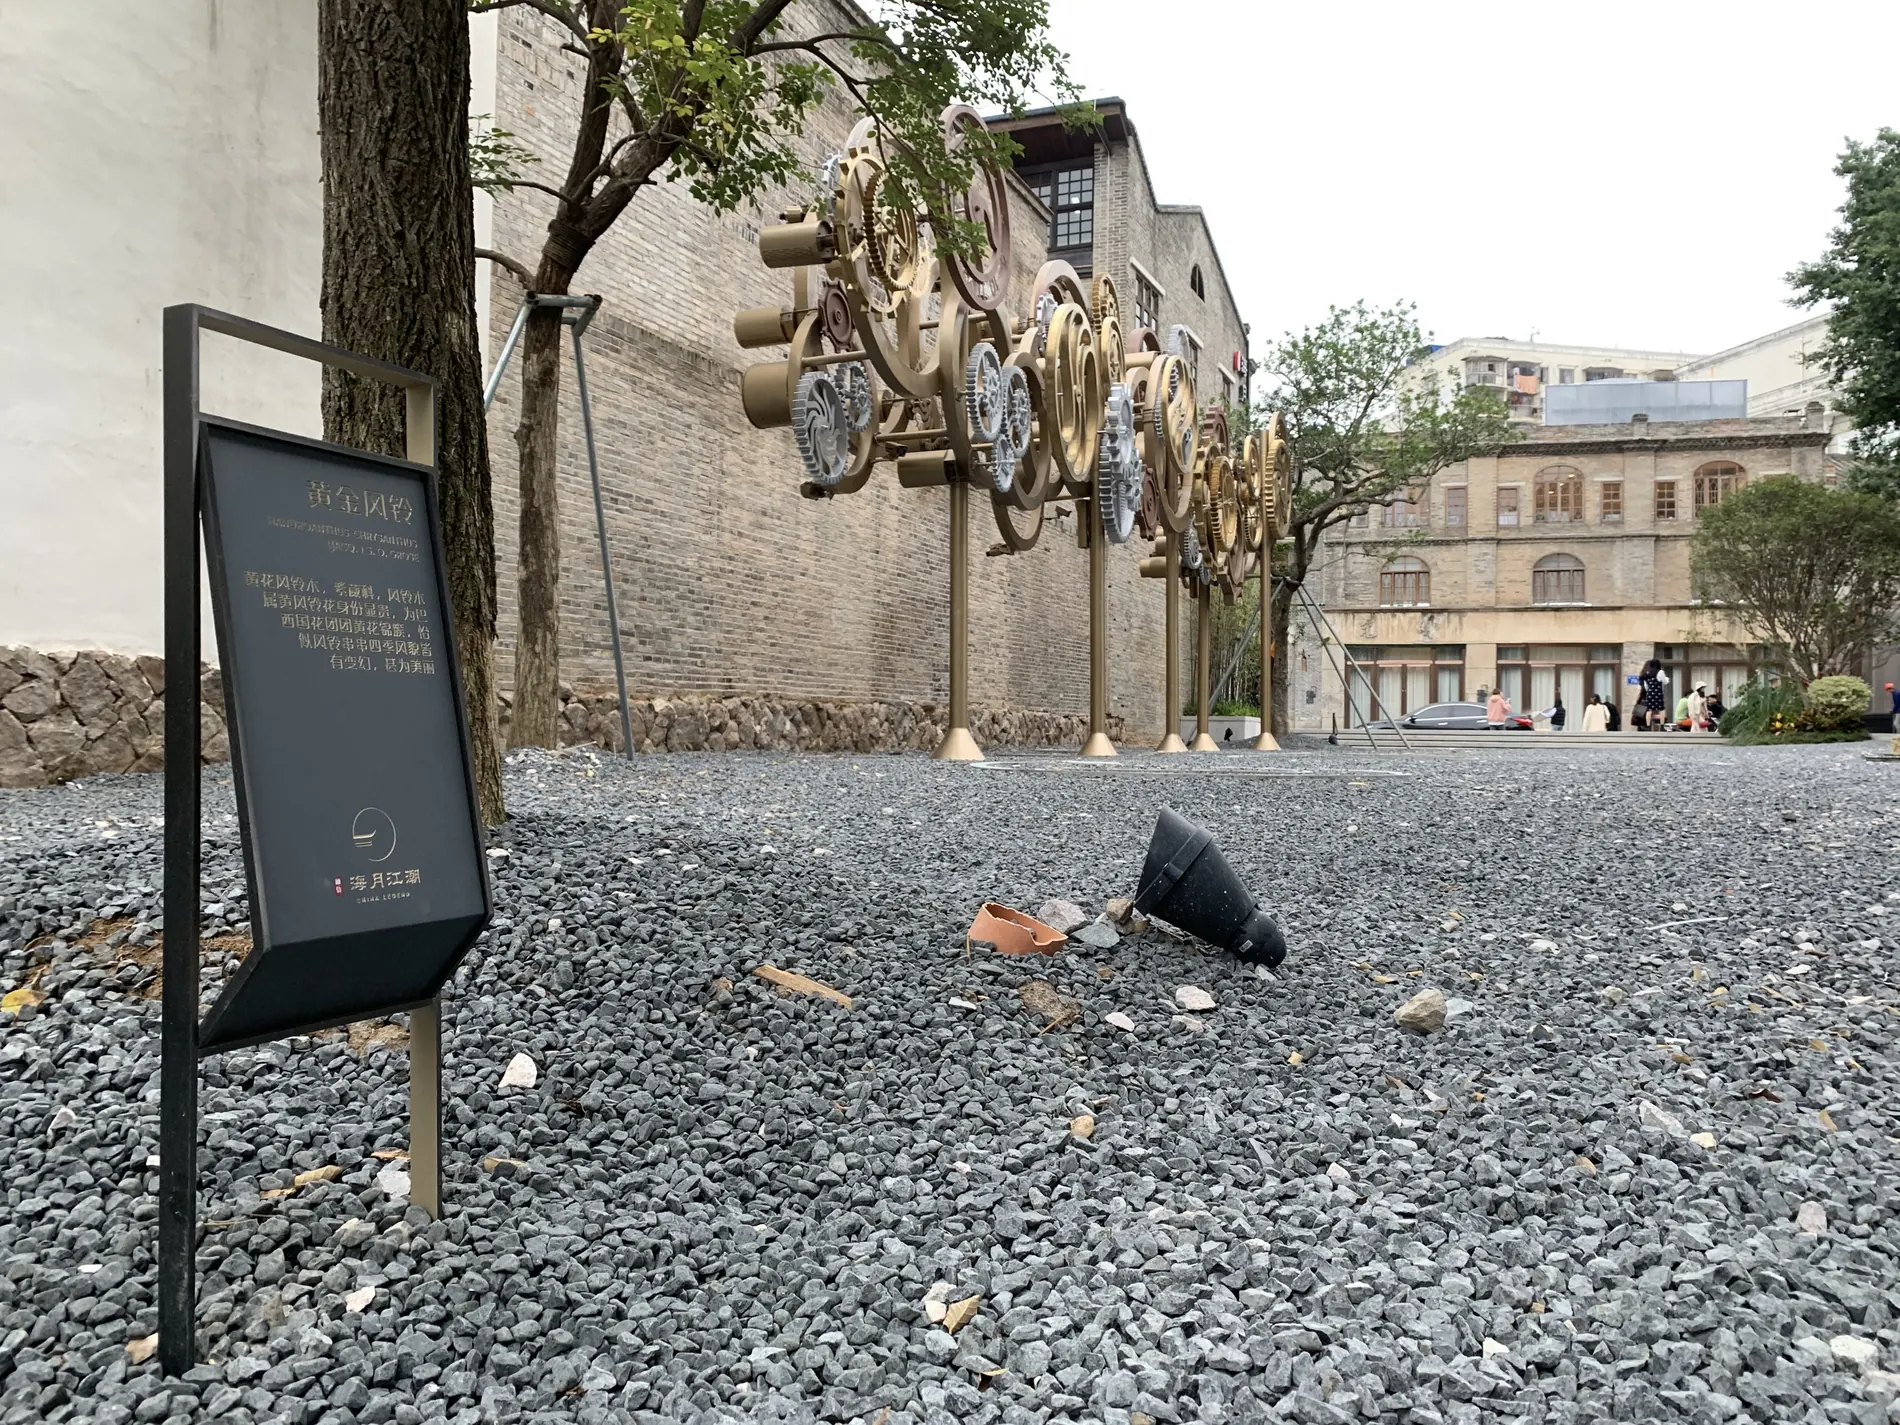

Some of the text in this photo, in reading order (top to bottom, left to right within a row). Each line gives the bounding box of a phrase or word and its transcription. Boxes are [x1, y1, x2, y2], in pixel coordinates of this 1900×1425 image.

[307, 480, 413, 525] 黄金风铃
[349, 868, 421, 891] 海月江潮
